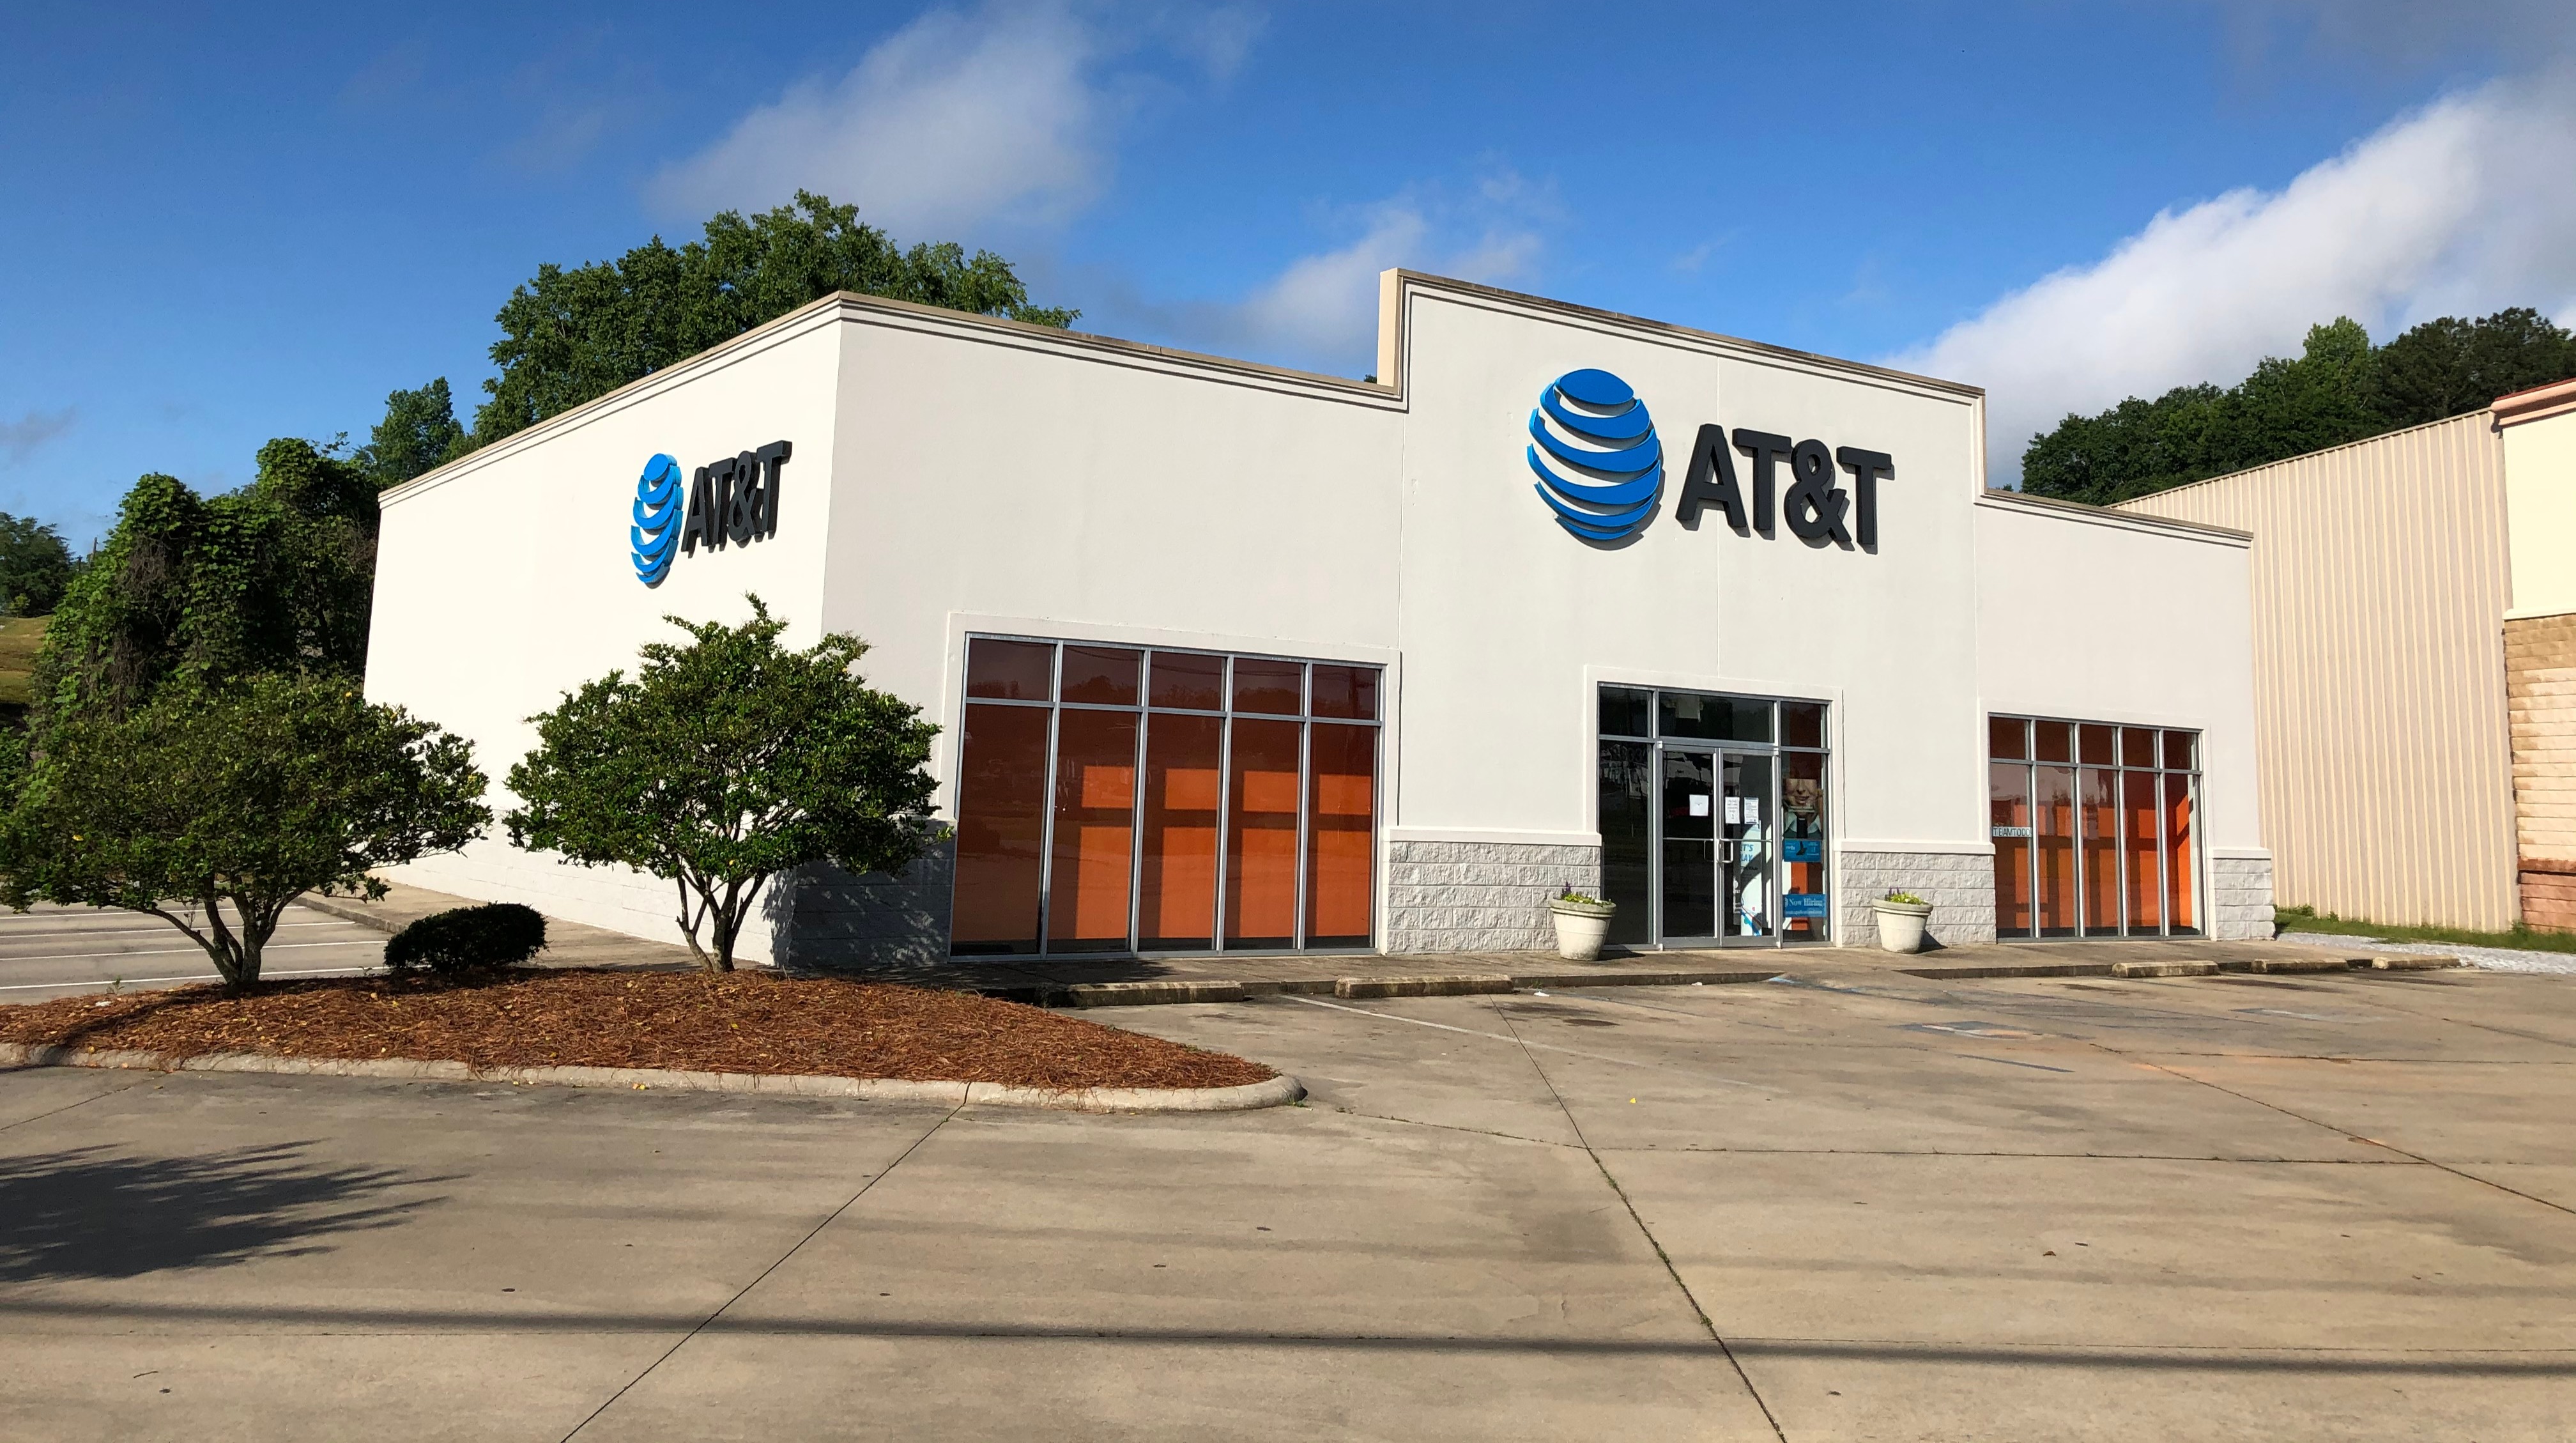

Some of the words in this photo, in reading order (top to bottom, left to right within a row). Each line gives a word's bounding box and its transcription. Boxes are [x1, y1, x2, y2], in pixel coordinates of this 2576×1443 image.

[680, 440, 792, 552] AT&T
[1675, 423, 1892, 546] AT&T
[1740, 854, 1753, 862] LAY
[1789, 898, 1802, 906] Now
